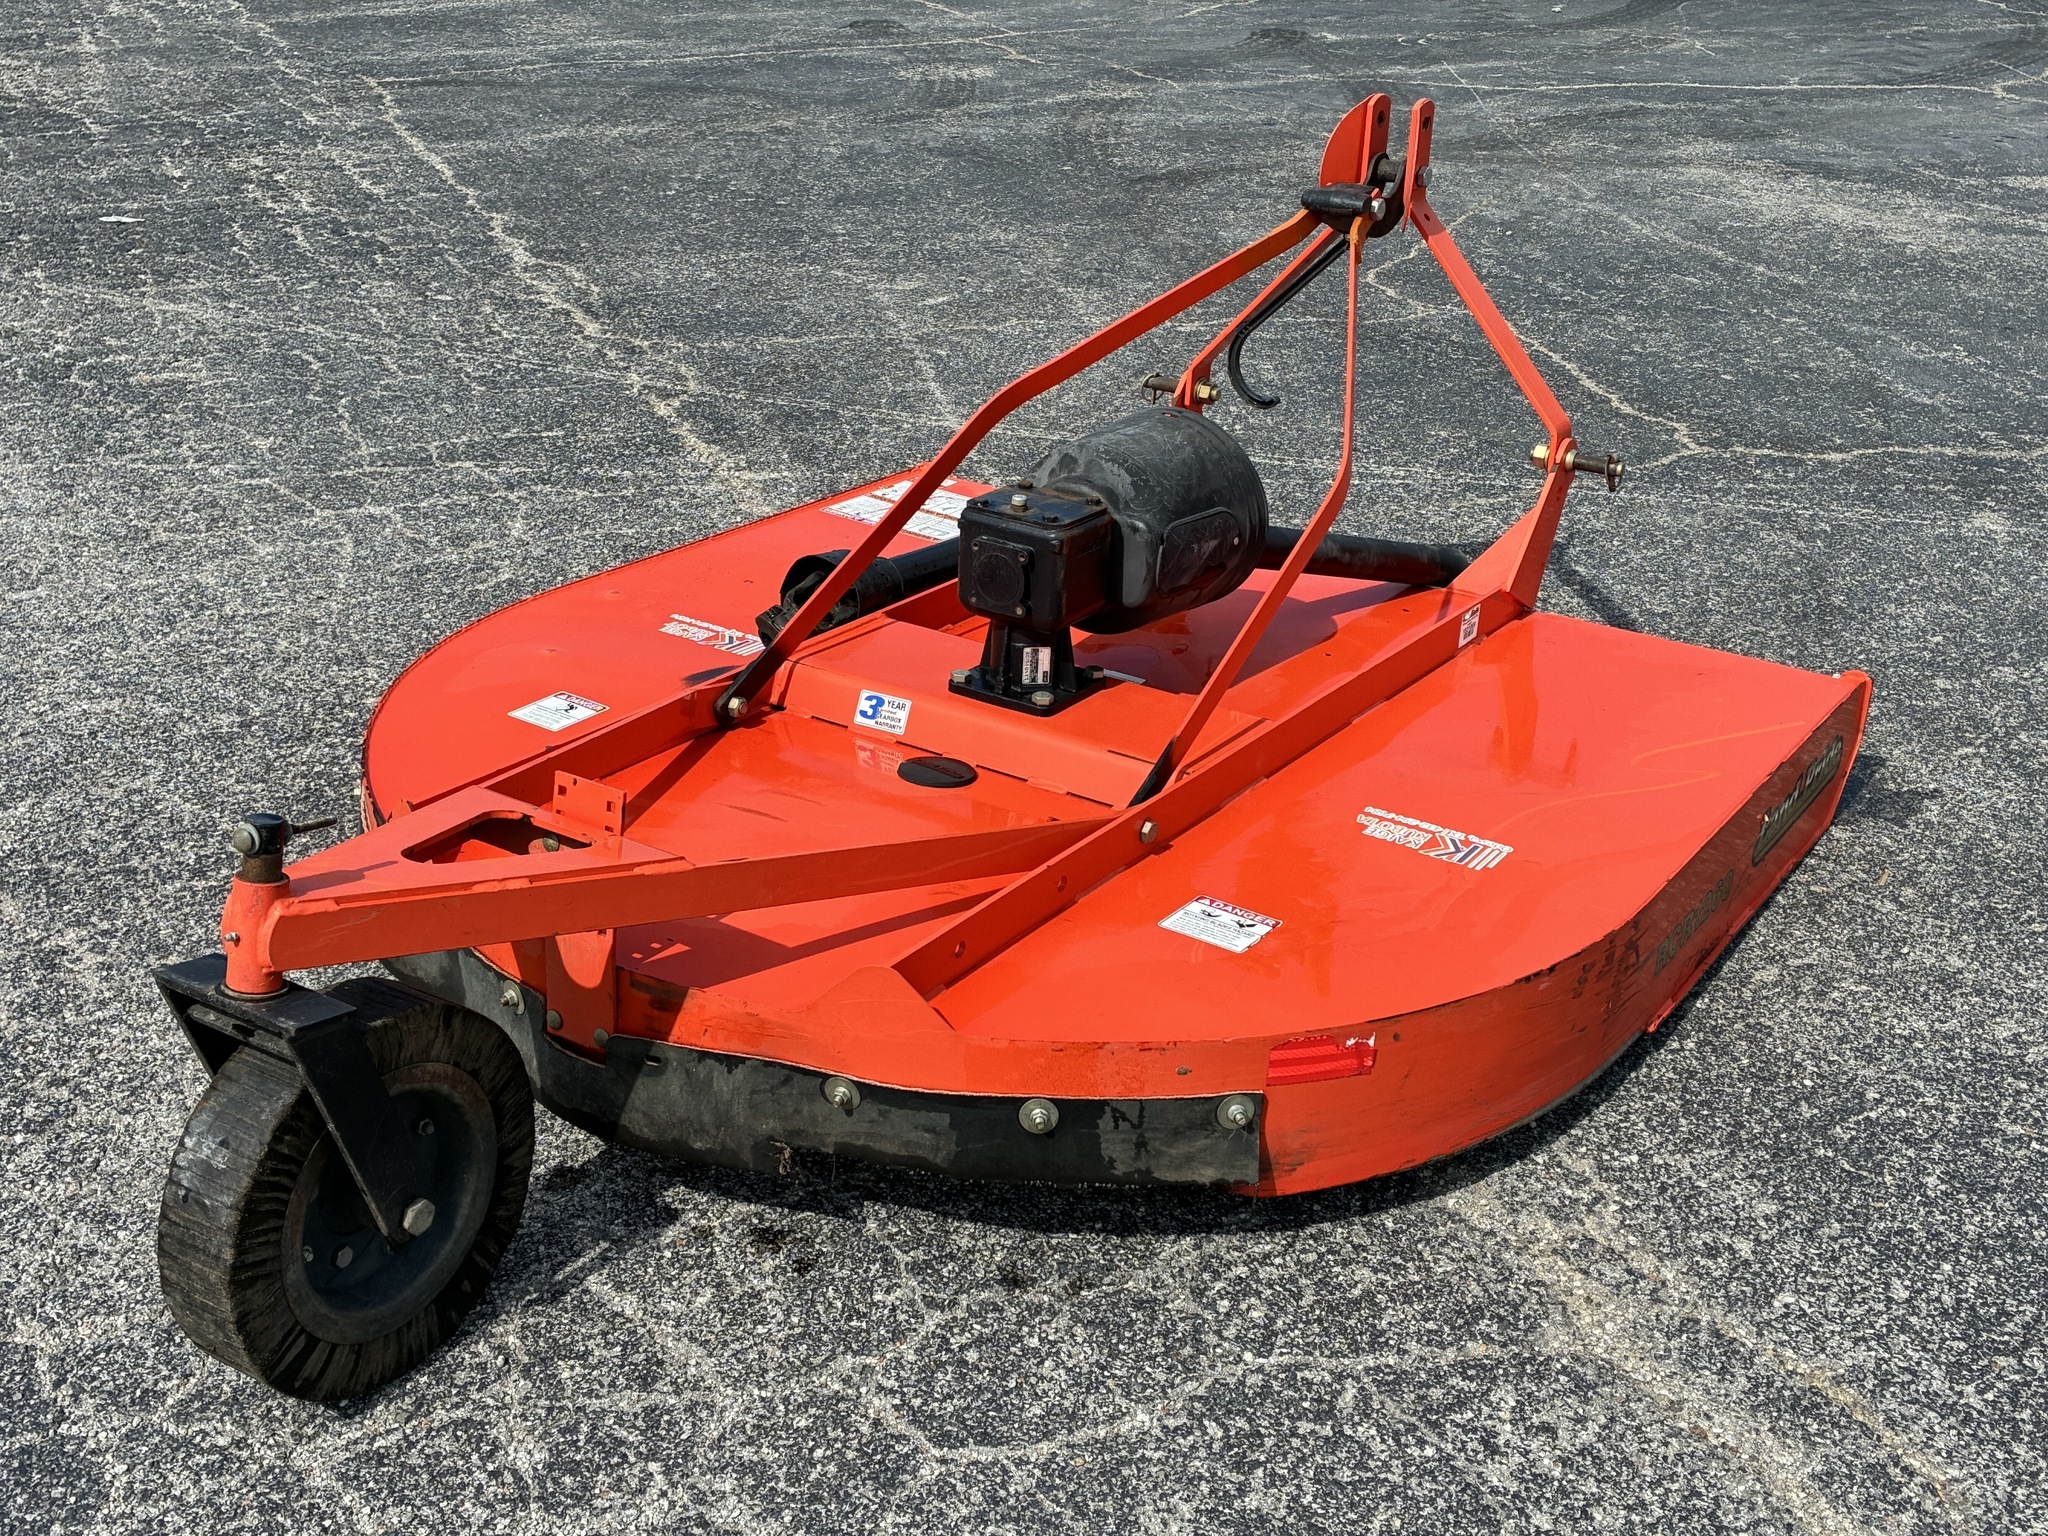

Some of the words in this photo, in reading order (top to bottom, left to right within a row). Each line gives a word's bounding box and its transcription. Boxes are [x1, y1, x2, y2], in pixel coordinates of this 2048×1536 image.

[859, 695, 885, 720] 3
[887, 699, 907, 712] YEAR
[875, 712, 902, 724] GEARBOX
[875, 720, 903, 731] WARRANTY
[1356, 814, 1433, 841] KUBOTA
[1362, 826, 1423, 849] KAIGE
[1211, 901, 1276, 928] DANGER
[1654, 868, 1735, 976] RCR1260
